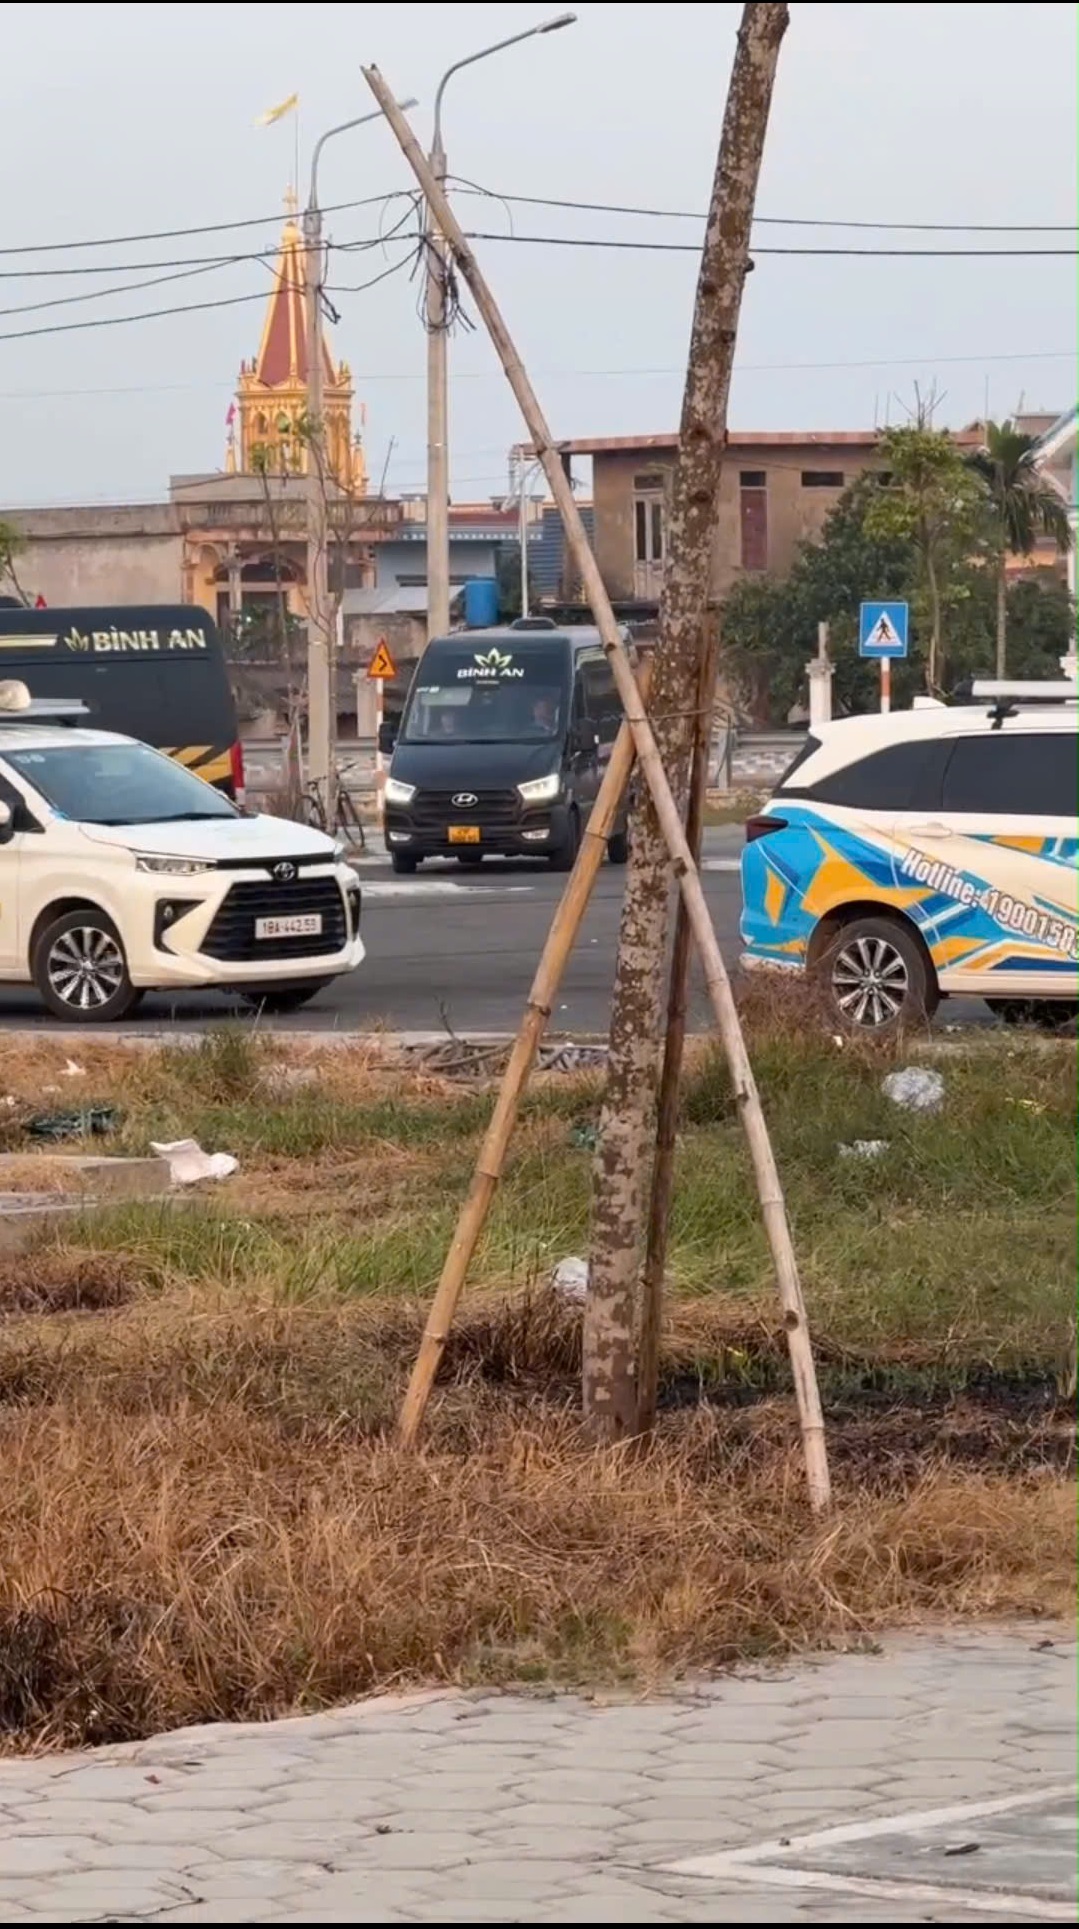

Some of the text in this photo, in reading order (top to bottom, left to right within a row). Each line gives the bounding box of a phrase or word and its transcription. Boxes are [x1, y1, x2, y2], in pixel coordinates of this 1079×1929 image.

[92, 625, 206, 651] BÌNH AN
[500, 668, 524, 677] AN
[900, 847, 982, 908] Hotline:
